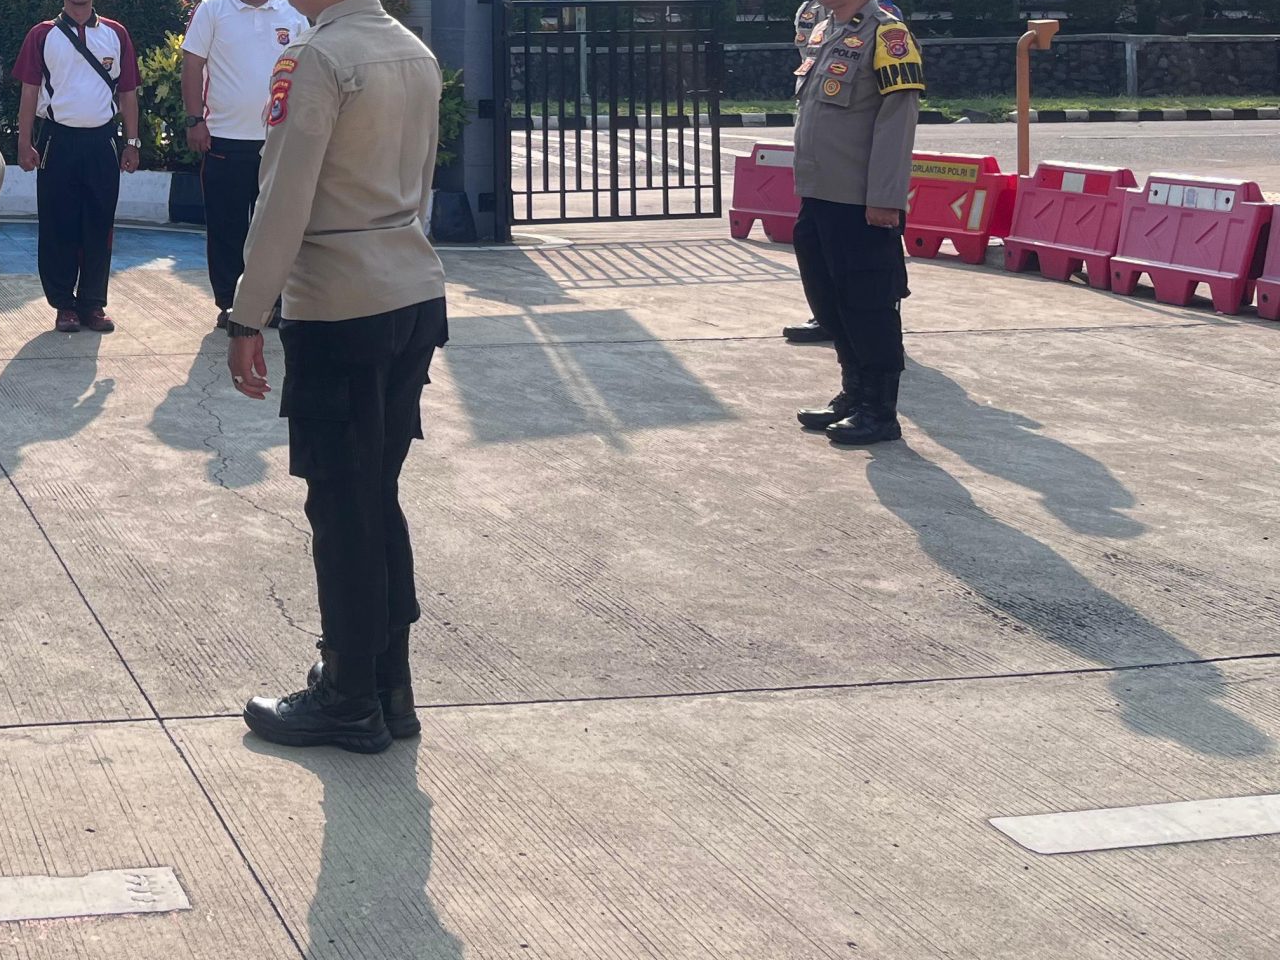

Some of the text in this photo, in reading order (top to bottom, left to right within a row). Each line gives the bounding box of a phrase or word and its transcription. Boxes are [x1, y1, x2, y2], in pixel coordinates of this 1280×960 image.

[832, 47, 861, 60] POLRI
[912, 164, 968, 176] ORLANTAS POLRI
